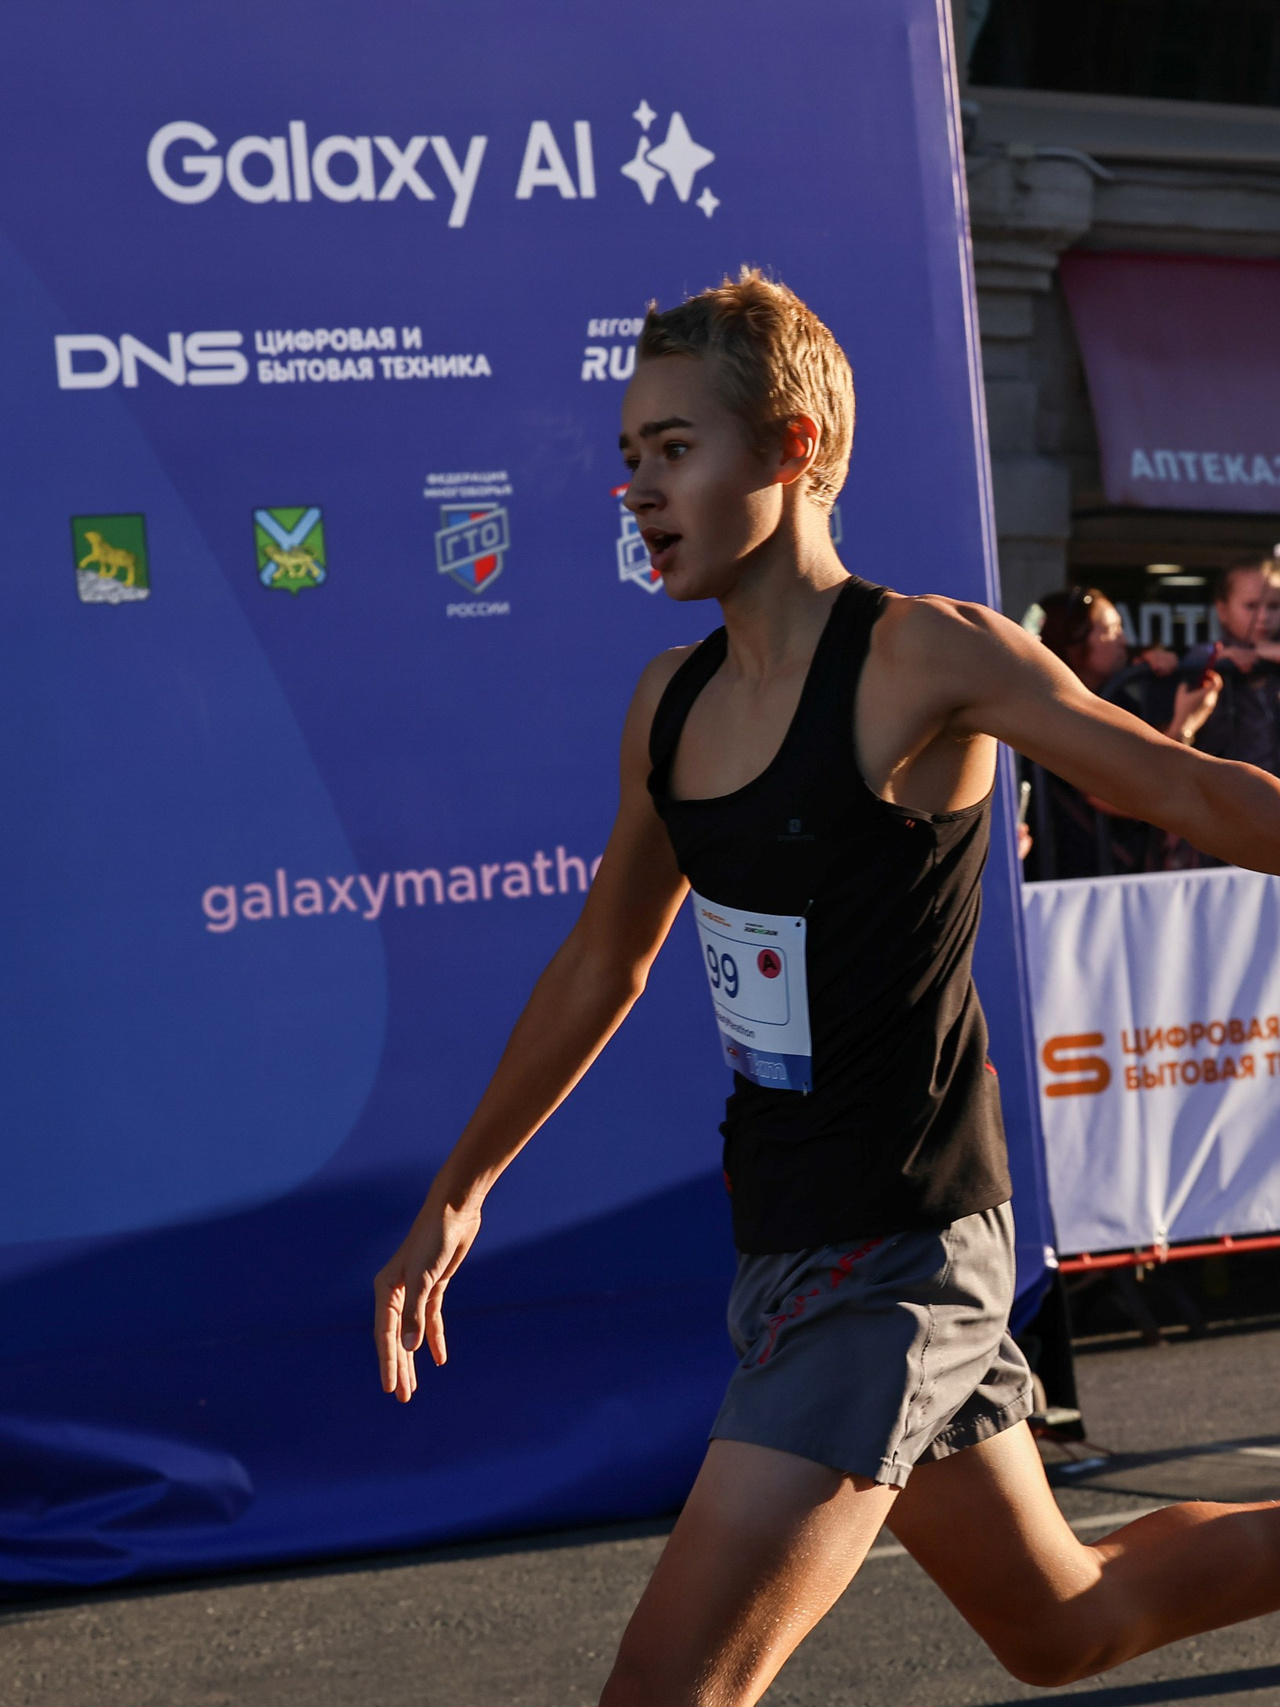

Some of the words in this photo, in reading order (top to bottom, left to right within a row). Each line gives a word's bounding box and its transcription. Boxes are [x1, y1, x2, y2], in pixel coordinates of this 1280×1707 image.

[147, 120, 488, 228] Galaxy
[515, 120, 597, 199] AI
[54, 331, 249, 389] DNS
[255, 328, 396, 354] ЦИФРОВАЯ
[402, 327, 422, 350] И
[258, 358, 375, 383] БЫТОВАЯ
[379, 354, 492, 380] ТЕХНИКА
[446, 521, 499, 562] ГТО
[1120, 1016, 1280, 1056] ЦИФРОВАЯ
[1123, 1054, 1256, 1092] БЫТОВАЯ
